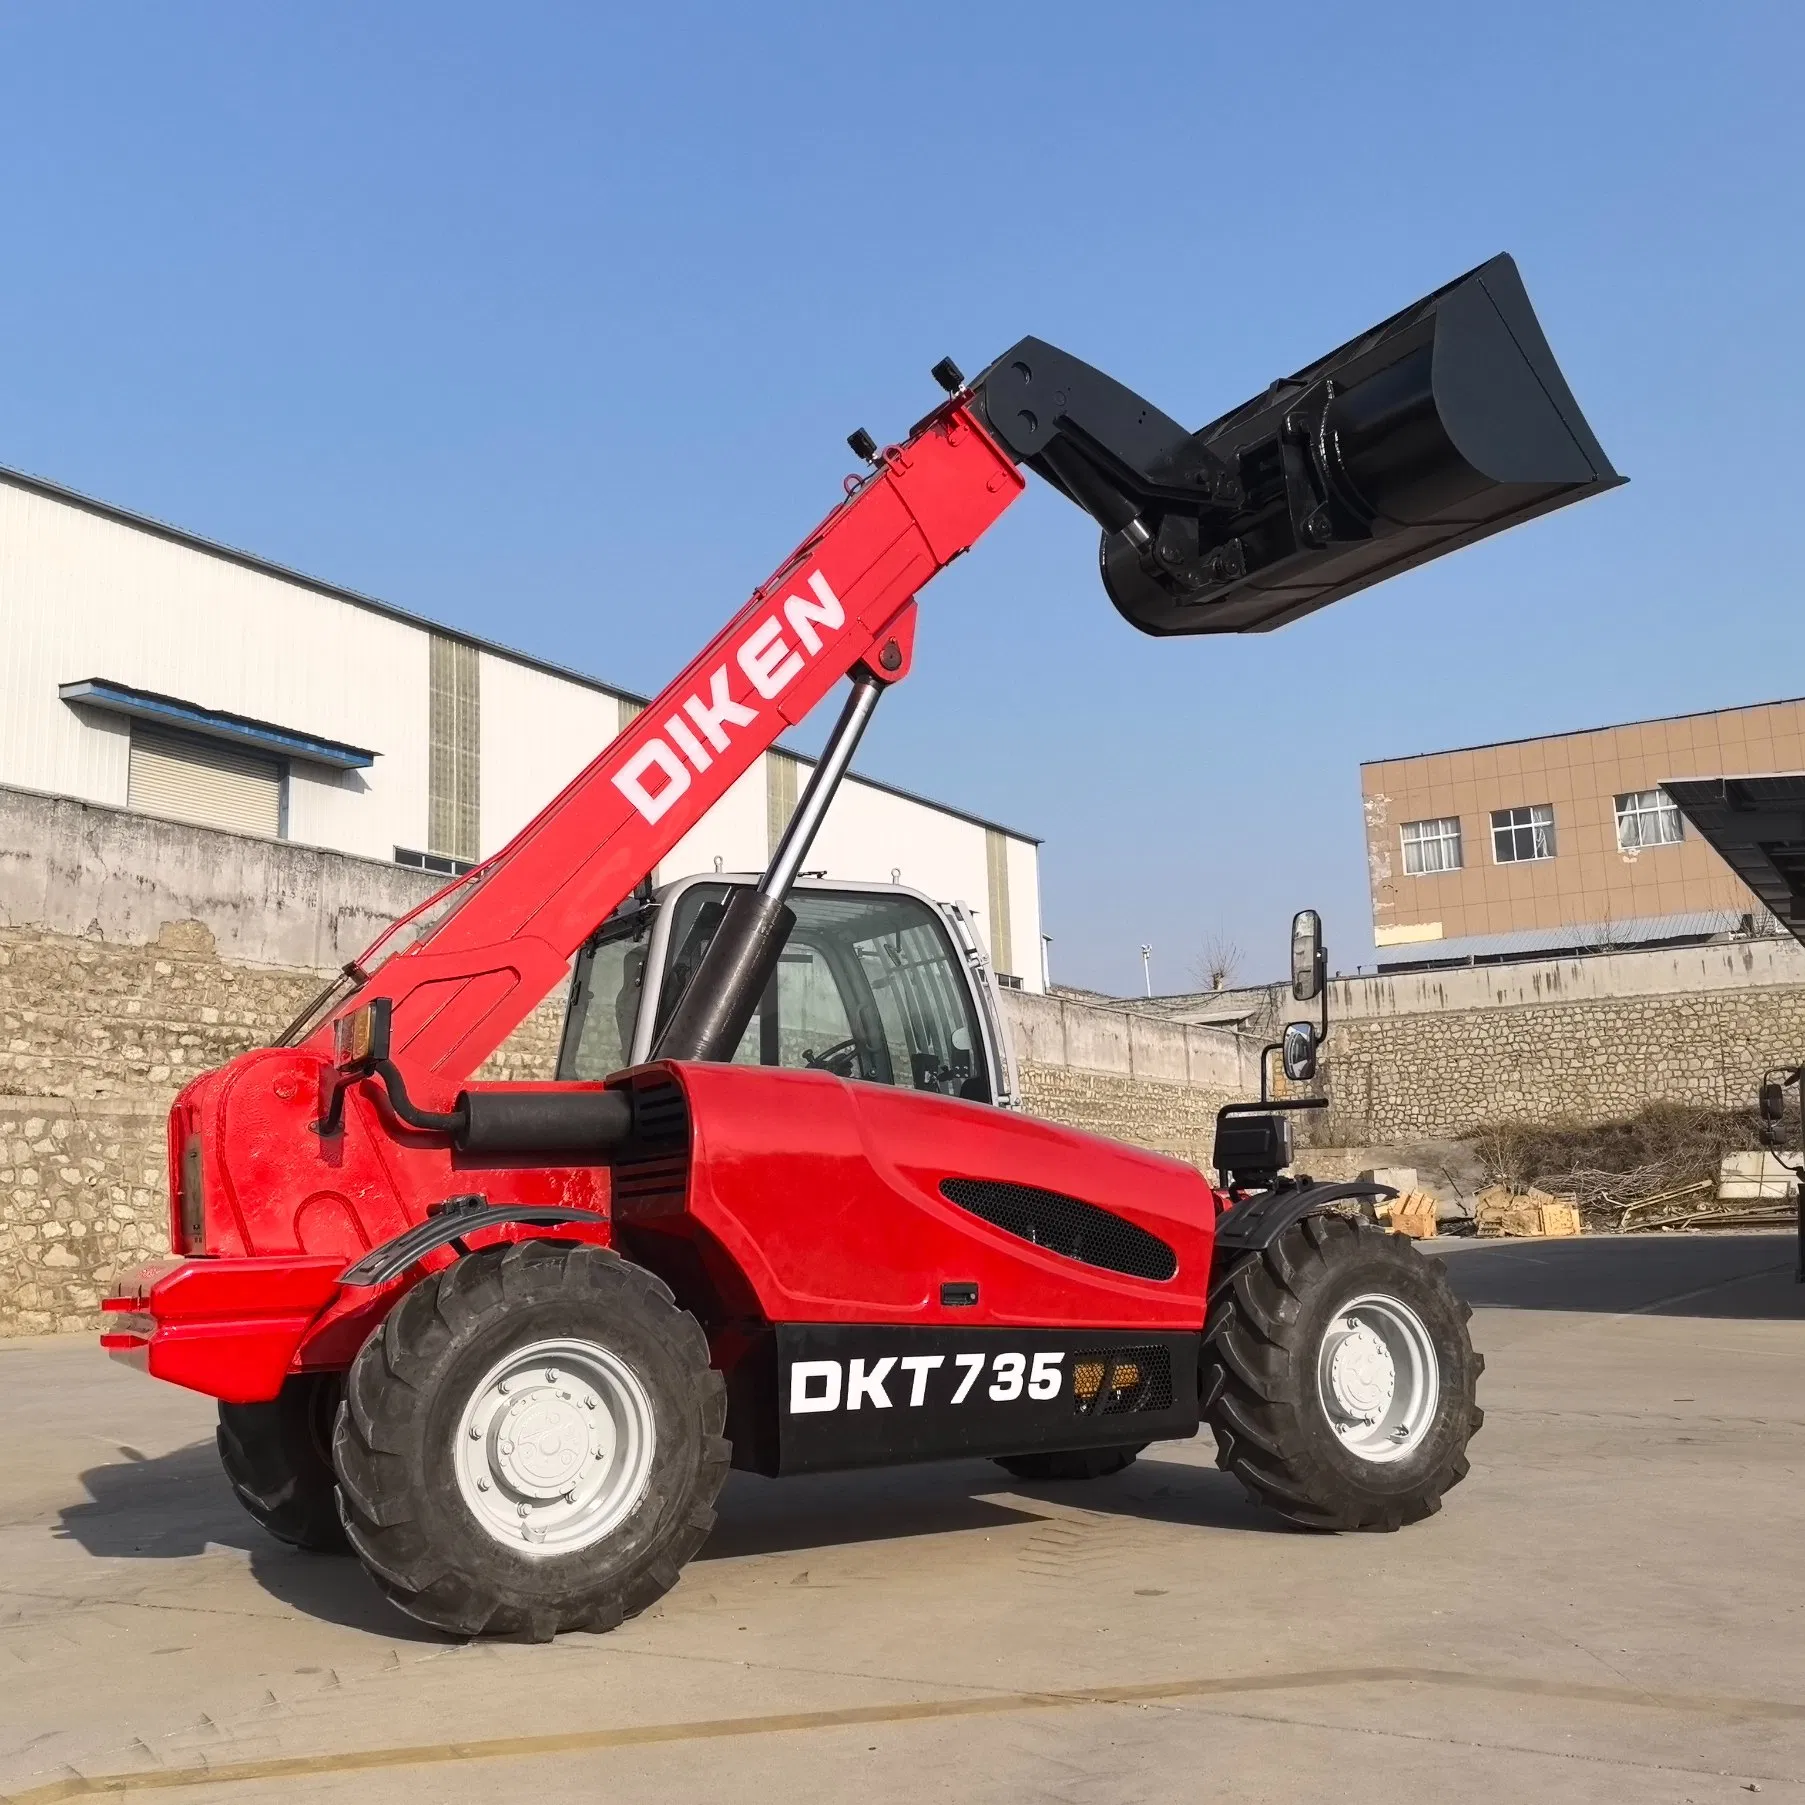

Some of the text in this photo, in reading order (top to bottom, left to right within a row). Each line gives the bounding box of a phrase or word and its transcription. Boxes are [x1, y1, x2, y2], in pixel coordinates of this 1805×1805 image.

[611, 569, 845, 825] DIKEN
[790, 1353, 1065, 1413] DKT 735
